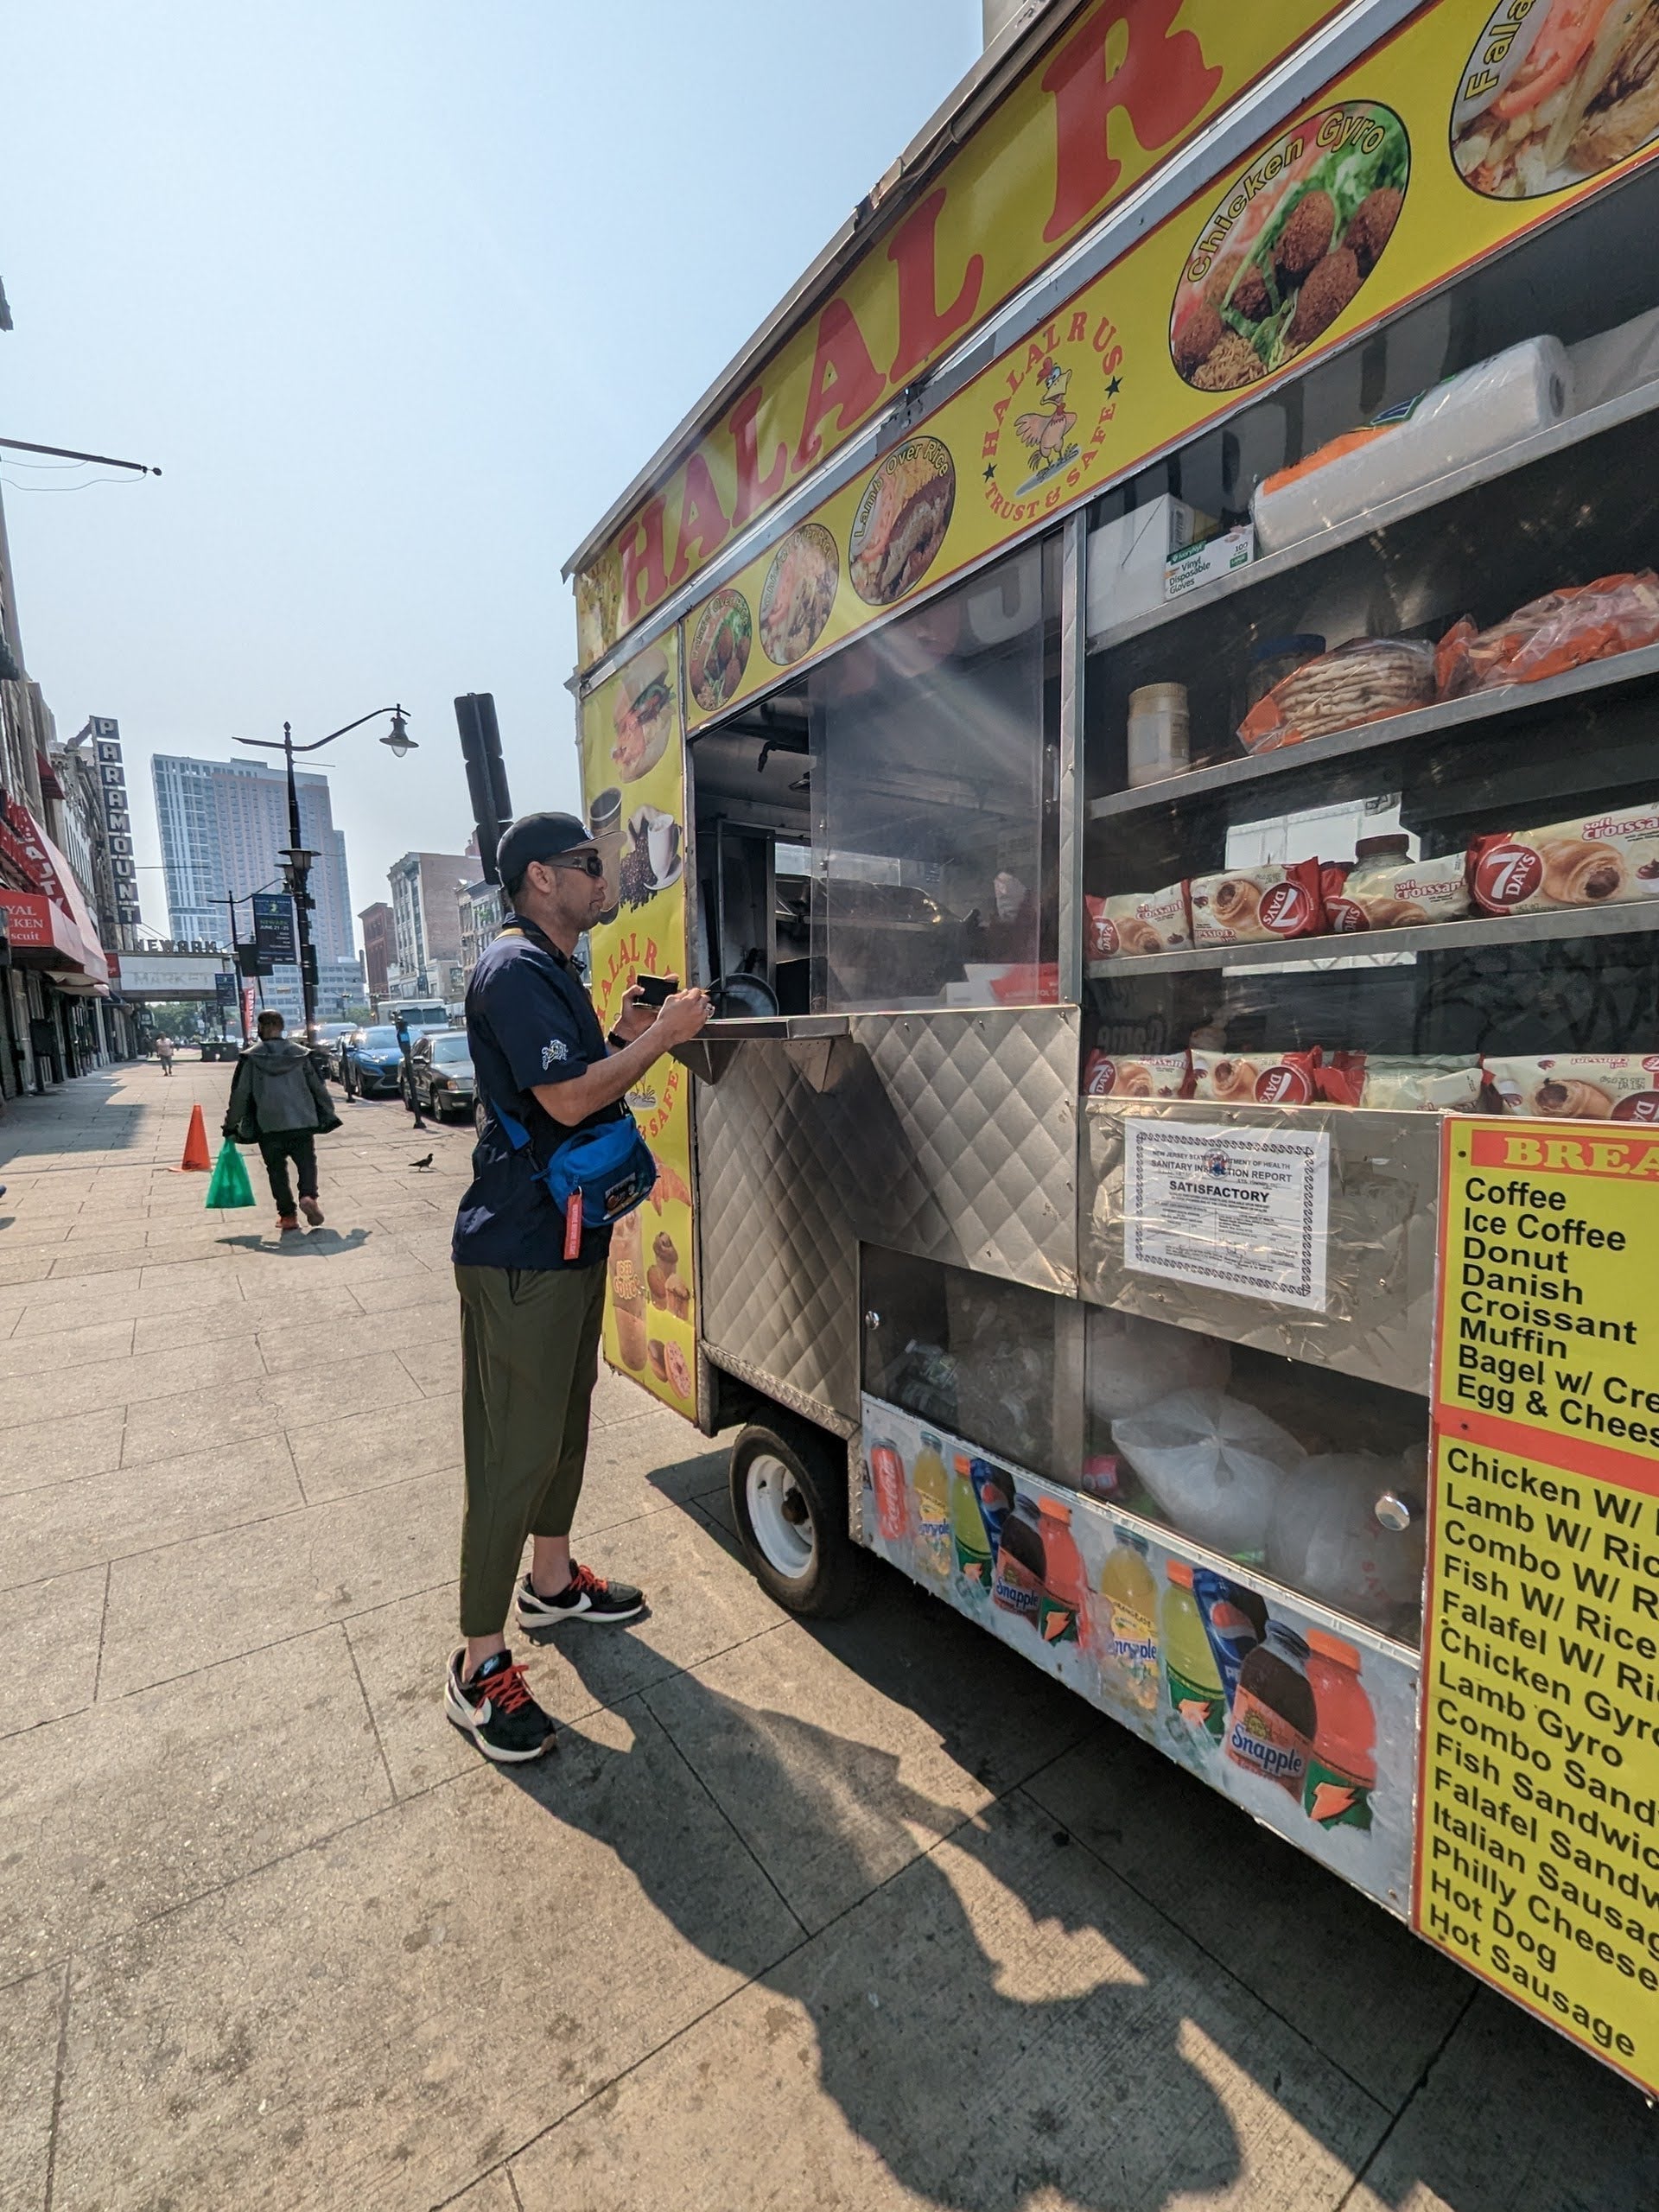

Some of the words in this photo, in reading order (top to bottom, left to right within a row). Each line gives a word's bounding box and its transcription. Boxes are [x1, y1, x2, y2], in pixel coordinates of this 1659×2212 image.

[1187, 137, 1305, 283] Chicken
[1316, 111, 1385, 154] Gyro
[618, 187, 984, 626] HALAL
[982, 324, 1060, 459] HALAL
[1067, 311, 1123, 376] RUS
[985, 481, 1039, 521] TRUST
[1045, 486, 1062, 508] &
[1066, 403, 1116, 487] SAFE
[854, 477, 883, 537] Lamb
[886, 443, 923, 475] Over
[924, 441, 949, 477] Rice
[1169, 563, 1211, 586] Disposable
[1169, 578, 1195, 594] Gloves
[1181, 556, 1202, 571] Vinyl
[99, 720, 136, 922] PARAMOUNT
[1583, 817, 1612, 830] soft
[1487, 852, 1525, 899] 7
[1505, 854, 1535, 896] DAYS
[0, 905, 37, 916] YAL
[10, 918, 43, 929] KEN
[1262, 891, 1287, 925] DAYS
[1270, 887, 1299, 927] 7
[133, 938, 218, 954] NEWARK
[650, 1071, 679, 1138] SAFE
[1096, 1064, 1114, 1094] DAYS
[1151, 1159, 1193, 1172] SANITARY
[1251, 1170, 1293, 1183] REPORT
[1169, 1180, 1270, 1203] SATISFACTORY
[1263, 1161, 1291, 1170] HEALTH
[1465, 1177, 1567, 1211] Coffee
[1464, 1236, 1568, 1274] Donut
[1465, 1207, 1507, 1236] Ice
[1517, 1213, 1626, 1251] Coffee
[1462, 1263, 1584, 1306] Danish
[1460, 1290, 1637, 1345] Croissant
[1460, 1316, 1567, 1360] Muffin
[1458, 1373, 1515, 1414] Egg
[1526, 1390, 1549, 1418] &
[1459, 1344, 1545, 1386] Bagel
[1555, 1370, 1593, 1396] w/
[1603, 1376, 1659, 1414] Cre
[1447, 1447, 1580, 1510] Chicken
[1593, 1488, 1643, 1529] W/
[1446, 1483, 1535, 1533] Lamb
[1546, 1513, 1592, 1552] W/
[1445, 1520, 1561, 1580] Combo
[1573, 1561, 1621, 1604] W/
[995, 1576, 1038, 1610] Snapple
[1444, 1554, 1509, 1601] Fish
[1521, 1581, 1565, 1622] W/
[1577, 1604, 1657, 1660] Rice
[1440, 1627, 1571, 1706] Chicken
[1443, 1589, 1547, 1656] Falafel
[1559, 1636, 1605, 1679] W/
[1617, 1661, 1659, 1703] Ri
[1439, 1661, 1526, 1722] Lamb
[1537, 1708, 1624, 1768] Gyro
[1231, 1724, 1302, 1774] Snapple
[1436, 1732, 1500, 1786] Fish
[1437, 1699, 1552, 1772] Combo
[1564, 1759, 1659, 1827] Sand
[1435, 1765, 1537, 1843] Falafel
[1433, 1801, 1526, 1875] Italian
[1432, 1869, 1483, 1923] Hot
[1493, 1906, 1556, 1974] Dog
[1433, 1835, 1516, 1907] Philly
[1528, 1894, 1659, 1992] Cheese
[1430, 1903, 1481, 1957] Hot
[1491, 1944, 1636, 2057] Sausage
